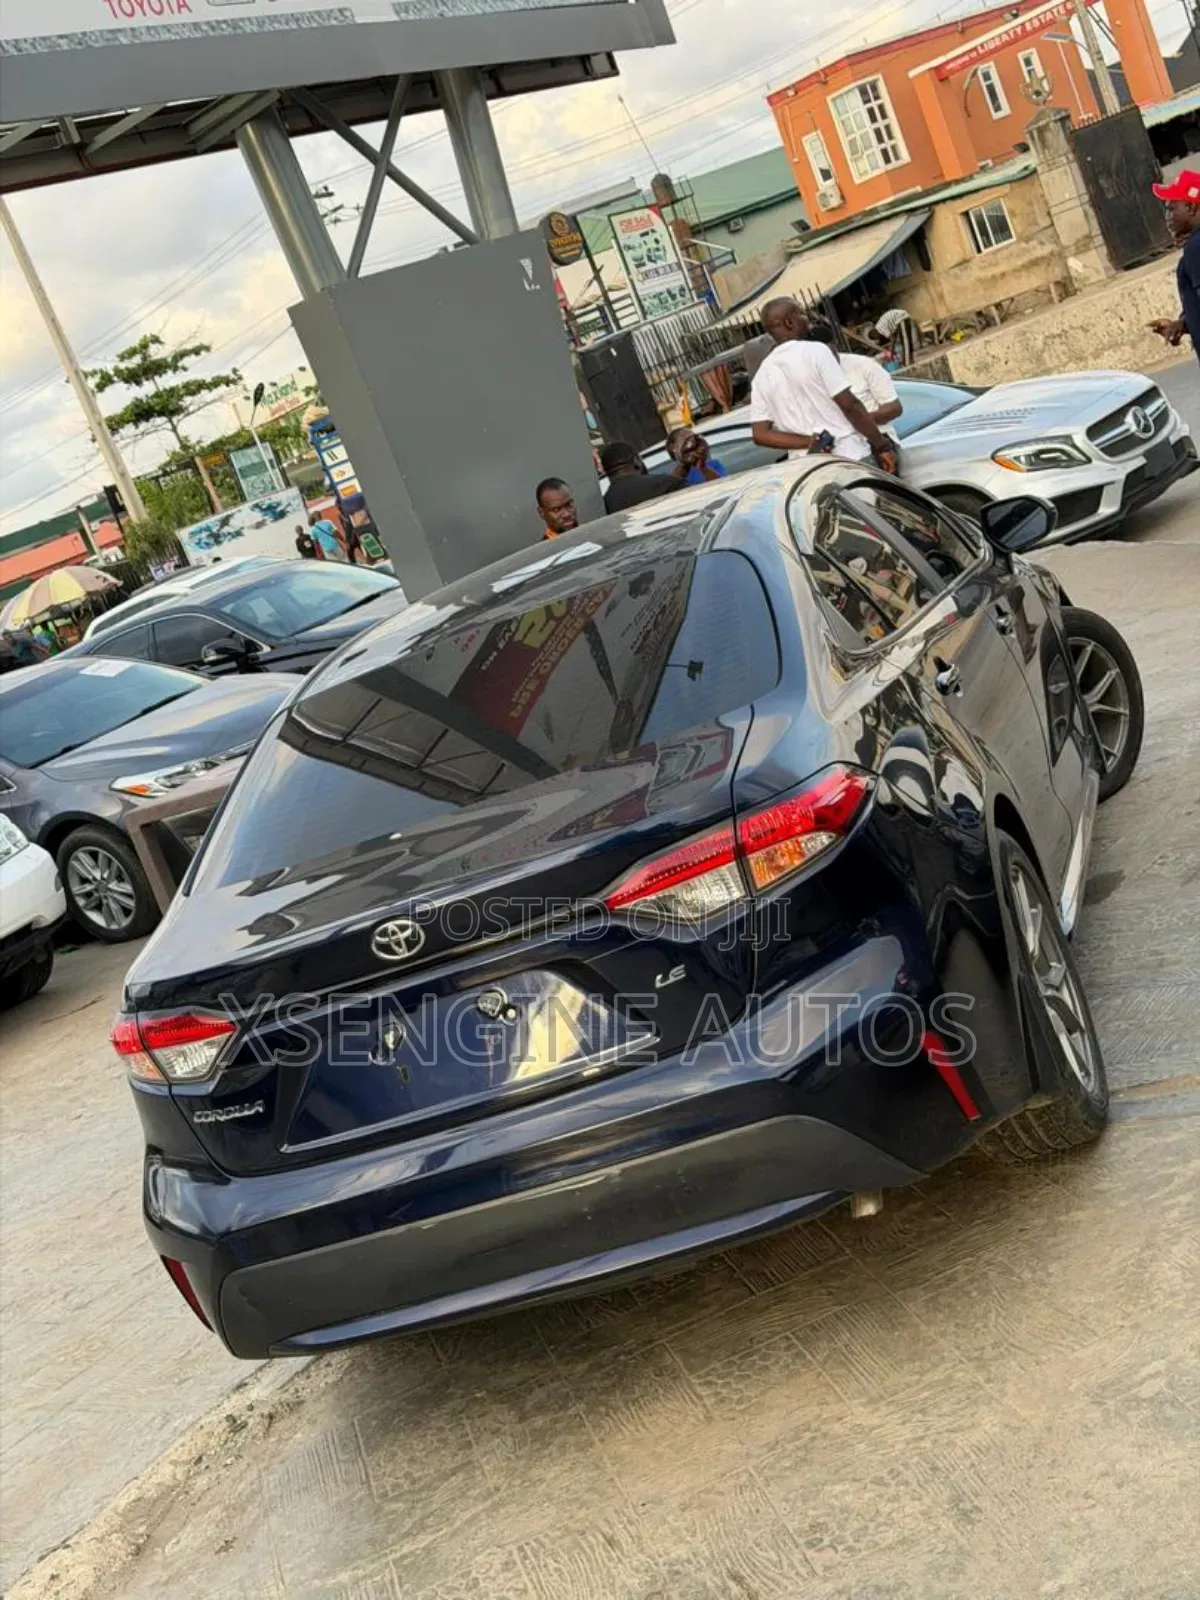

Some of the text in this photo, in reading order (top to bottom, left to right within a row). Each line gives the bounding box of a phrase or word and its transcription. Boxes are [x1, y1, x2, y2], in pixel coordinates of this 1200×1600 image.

[976, 27, 1024, 54] LIBERTY
[655, 963, 686, 988] LE
[193, 1099, 265, 1123] COROLLA
